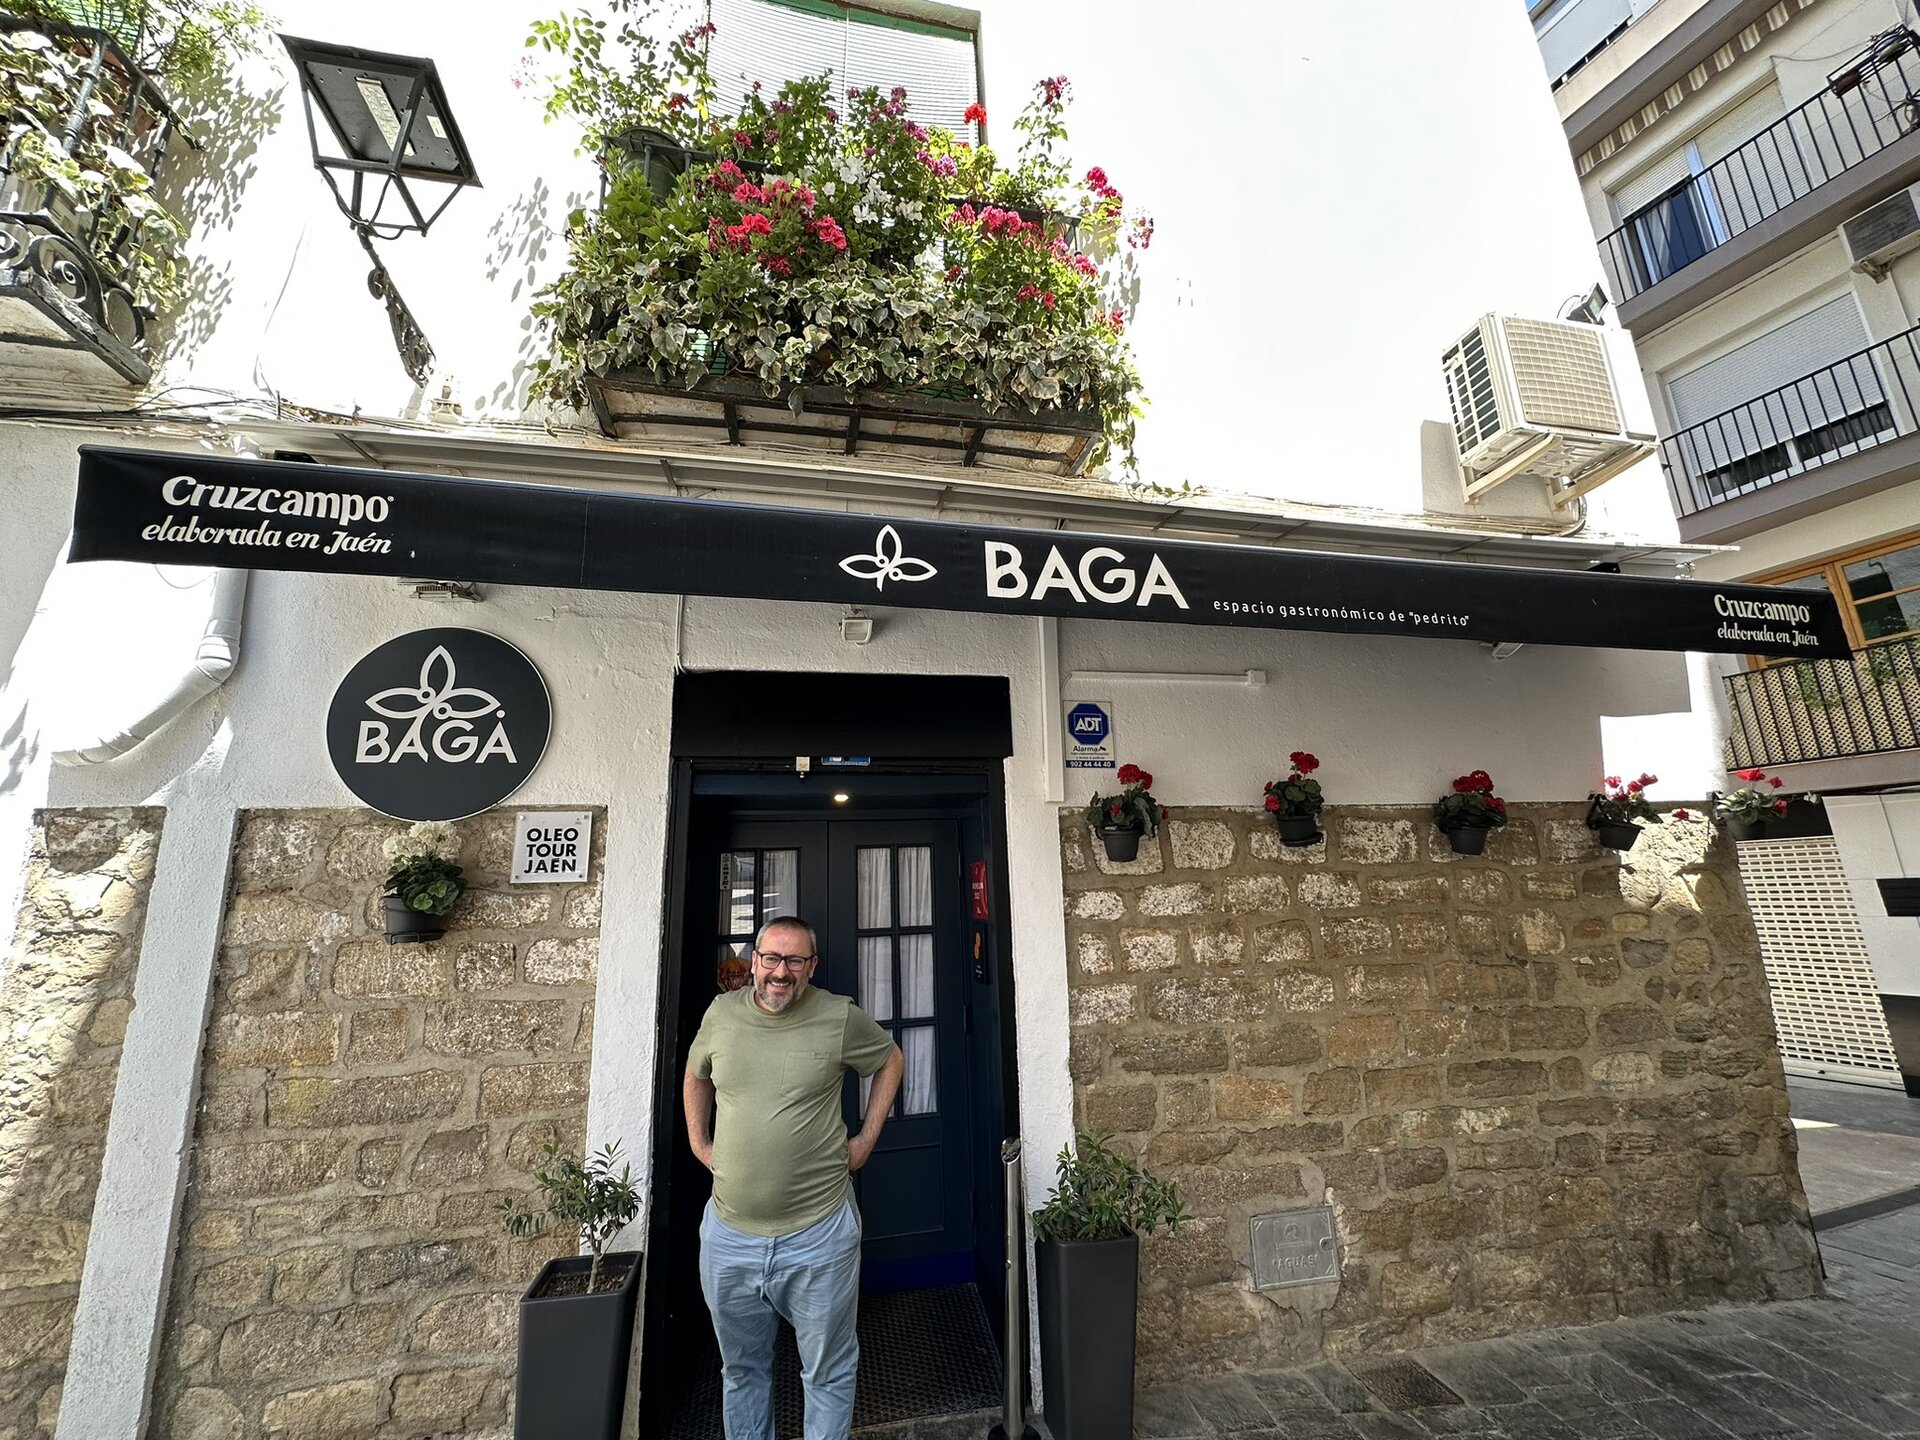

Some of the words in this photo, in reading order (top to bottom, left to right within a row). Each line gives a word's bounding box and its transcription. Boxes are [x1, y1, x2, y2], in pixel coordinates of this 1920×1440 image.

[162, 475, 390, 526] Cruzcampo
[141, 515, 282, 547] elaborada
[285, 530, 320, 549] en
[323, 530, 392, 555] Jaén
[984, 540, 1190, 610] BAGA
[1213, 600, 1274, 615] espacio
[1279, 605, 1385, 621] gastronómico
[1388, 610, 1405, 622] de
[1714, 594, 1810, 626] Cruzcampo
[1717, 621, 1776, 642] elaborada
[1776, 631, 1791, 643] en
[1792, 630, 1819, 647] Jaén
[1075, 717, 1102, 732] ADT
[355, 719, 518, 764] BAGA
[526, 828, 579, 842] OLEO
[526, 844, 577, 857] TOUR
